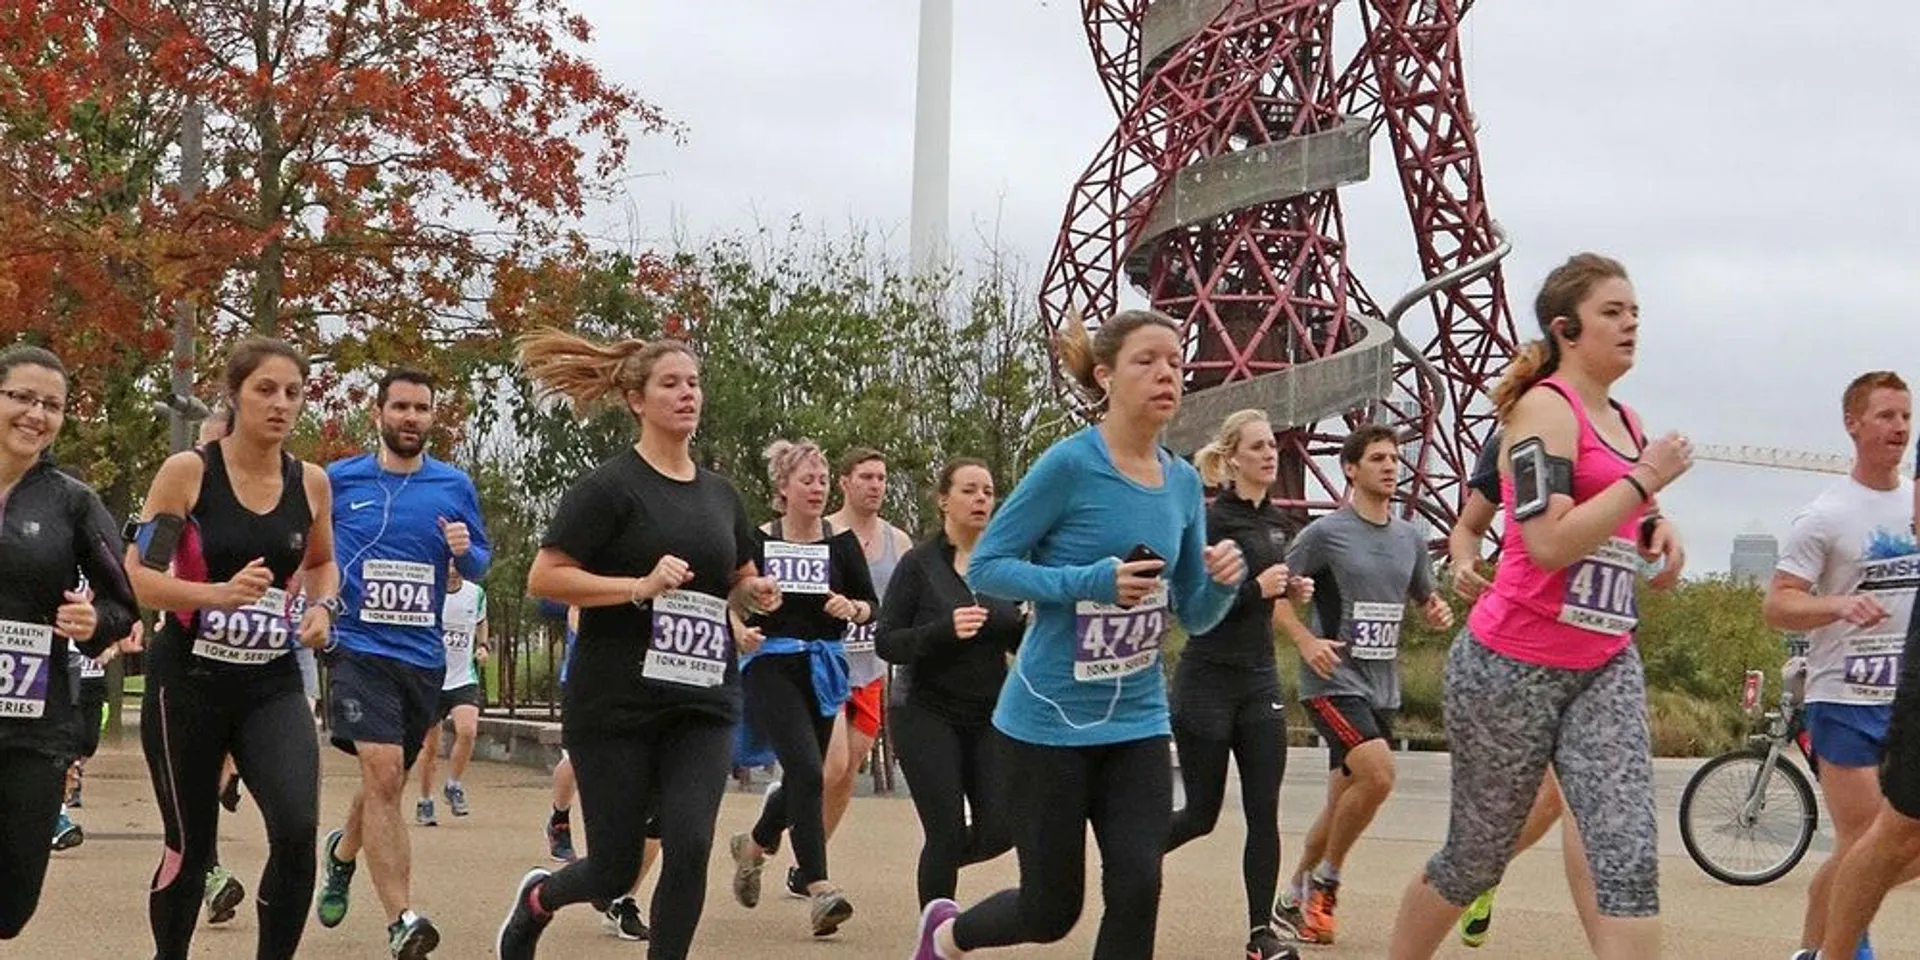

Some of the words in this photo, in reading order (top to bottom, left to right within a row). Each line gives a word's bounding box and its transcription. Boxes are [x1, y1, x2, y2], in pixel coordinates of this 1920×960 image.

[767, 558, 825, 583] 3103
[365, 582, 430, 611] 3094
[203, 610, 287, 649] 3076
[398, 614, 428, 622] SERIES
[655, 614, 725, 659] 3024
[1083, 609, 1162, 658] 4742
[204, 644, 240, 660] 10KM
